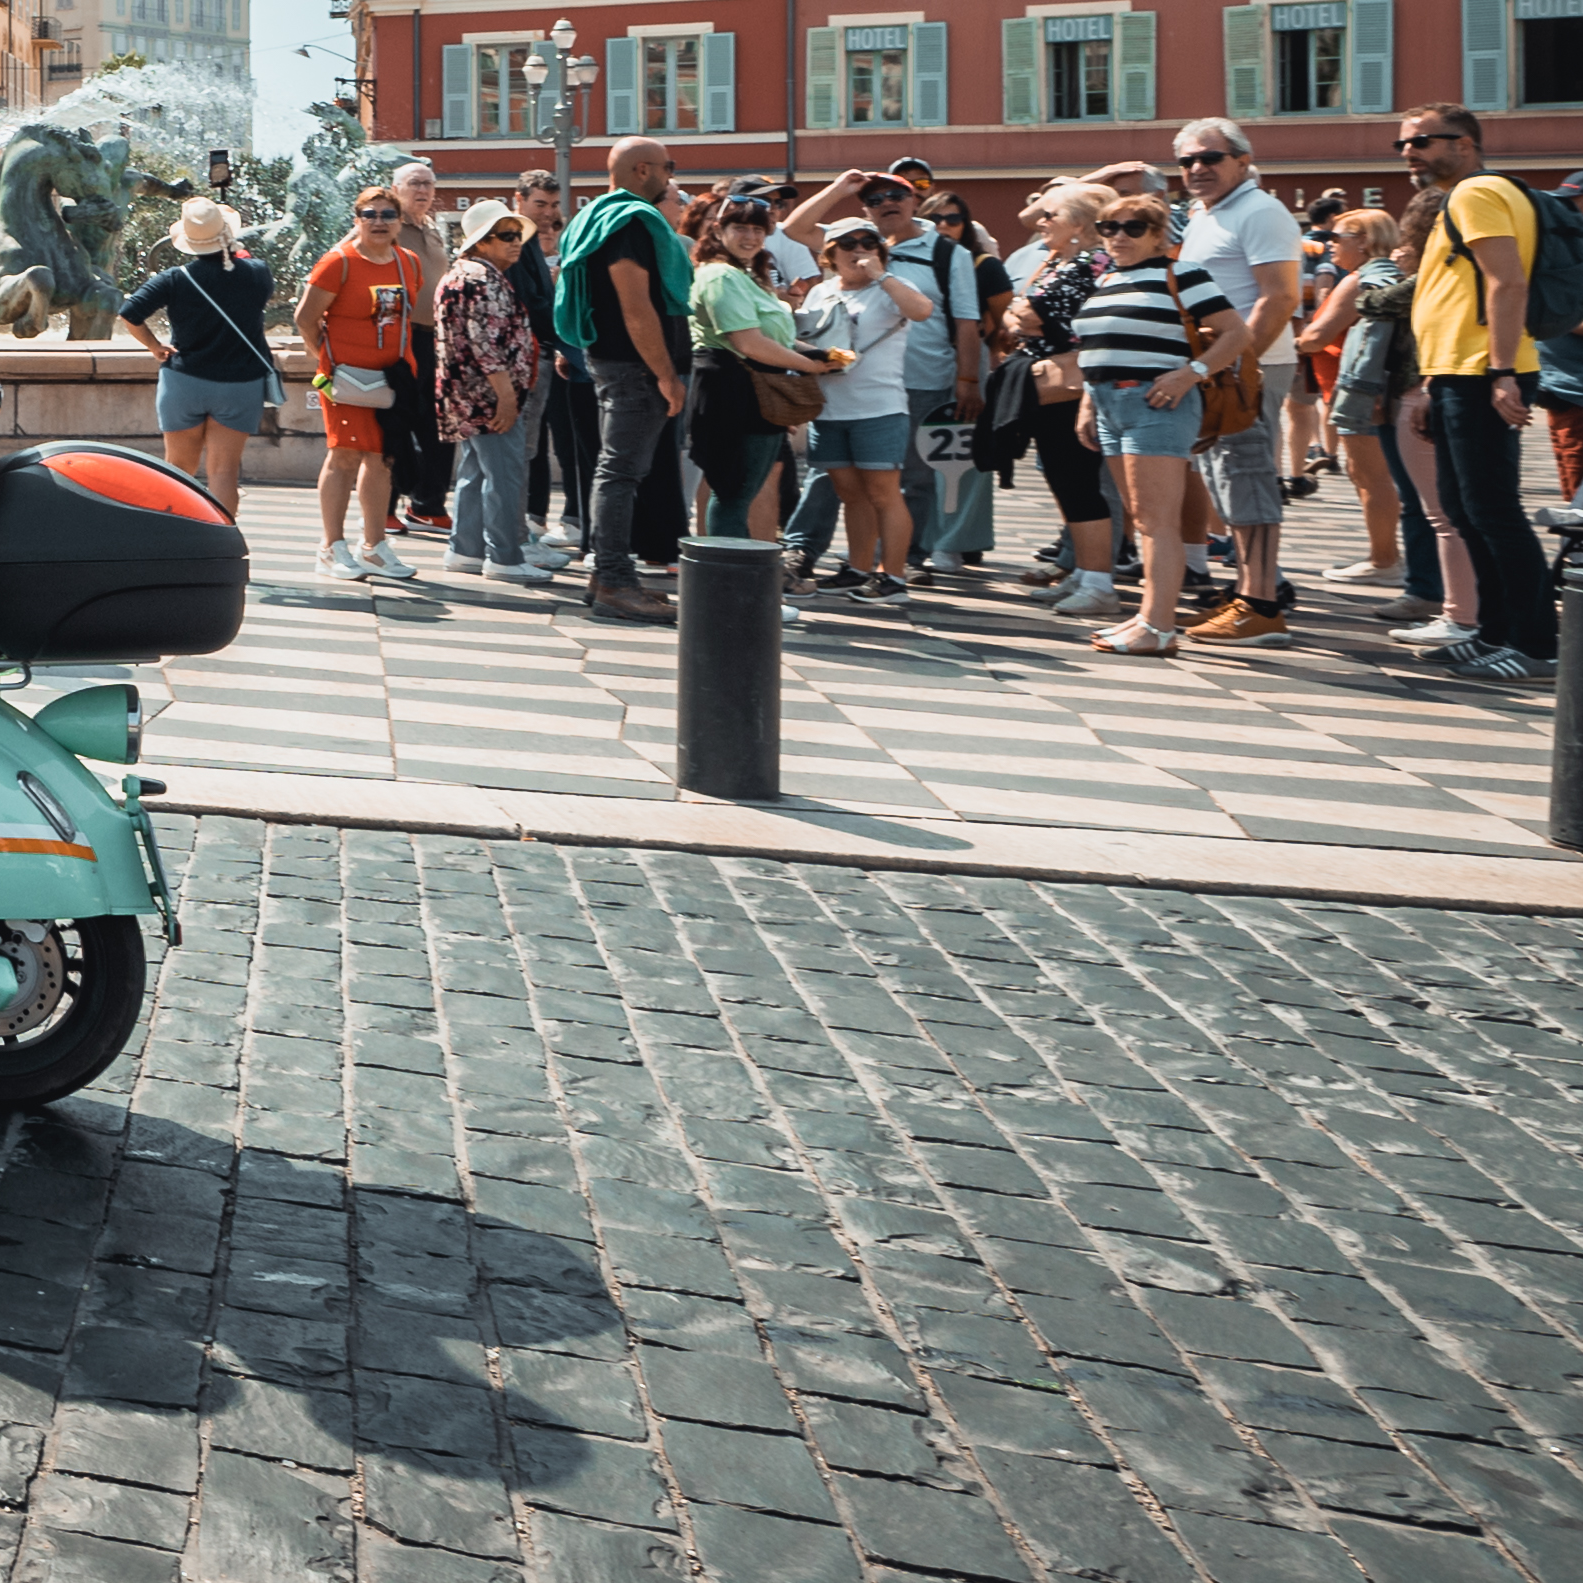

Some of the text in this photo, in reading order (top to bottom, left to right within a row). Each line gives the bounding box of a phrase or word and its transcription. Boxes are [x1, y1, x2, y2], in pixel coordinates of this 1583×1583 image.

[1047, 16, 1111, 41] HOTEL
[1275, 4, 1344, 29] HOTEL
[847, 27, 906, 49] HOTEL
[927, 428, 975, 462] 23
